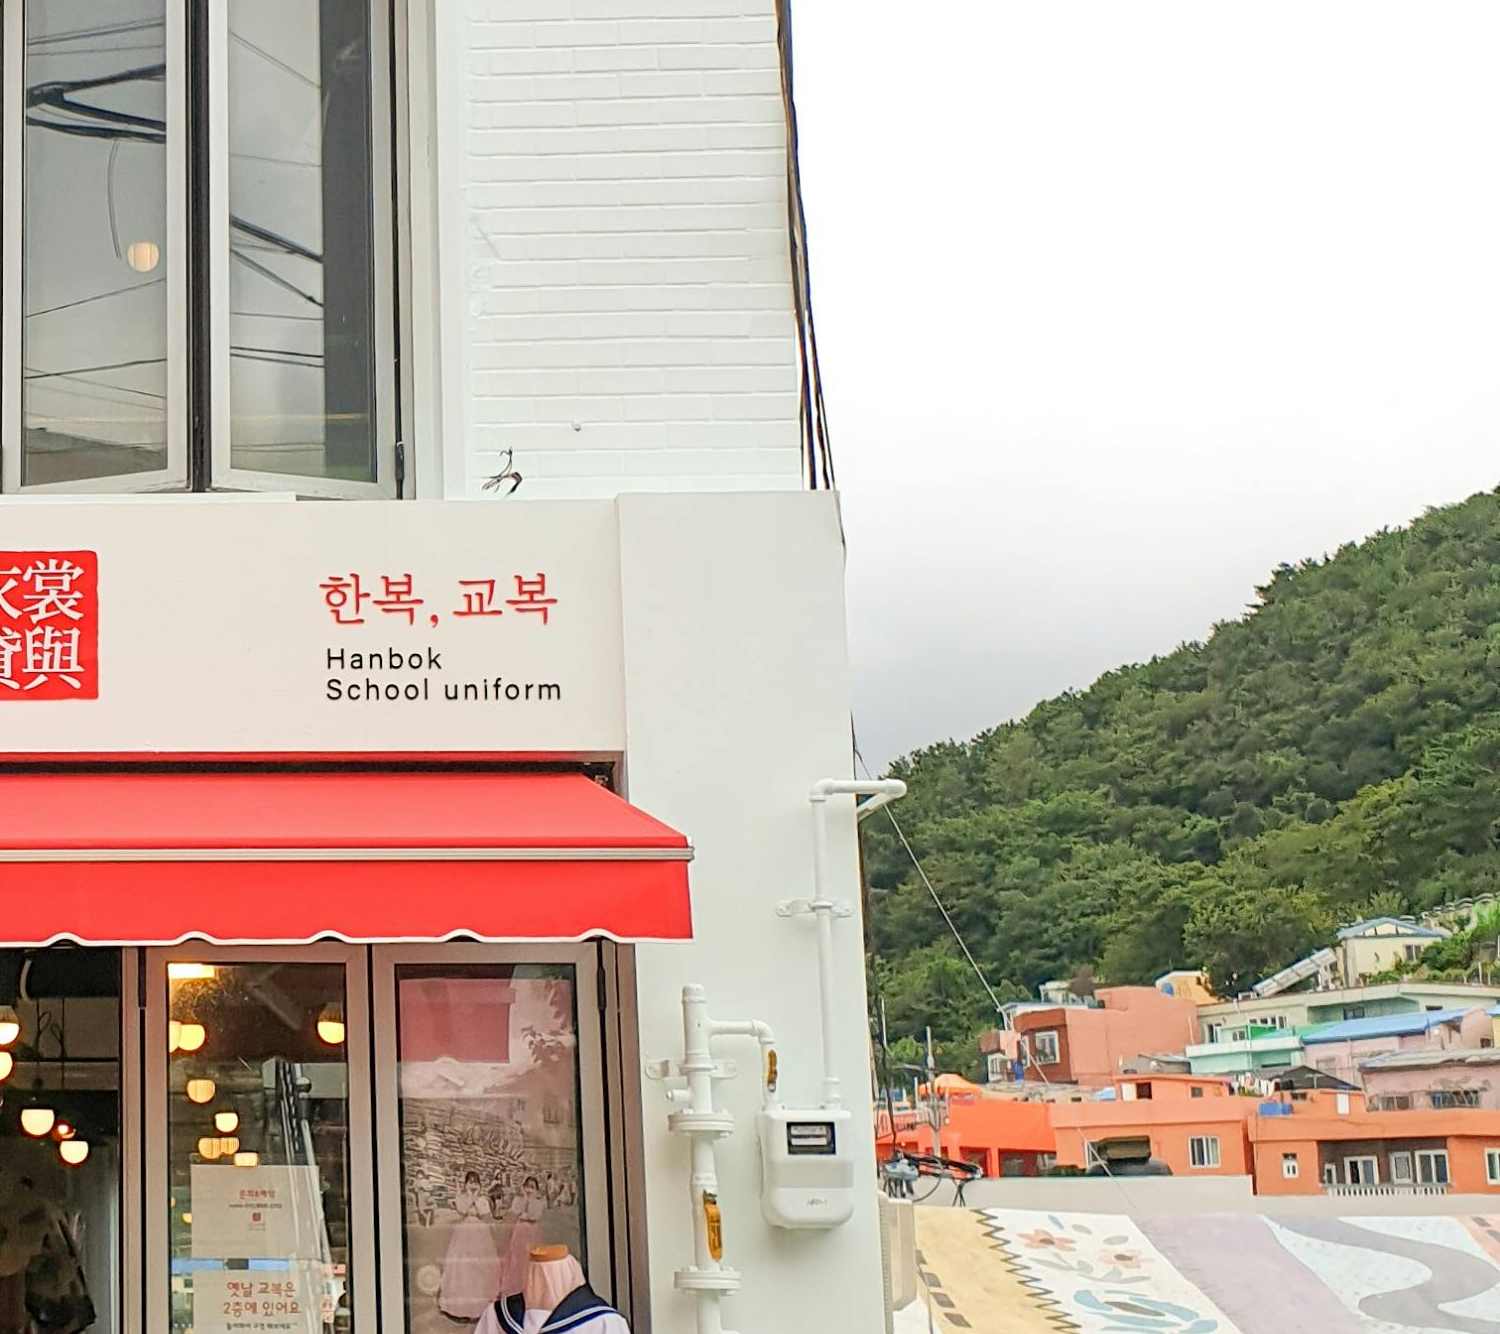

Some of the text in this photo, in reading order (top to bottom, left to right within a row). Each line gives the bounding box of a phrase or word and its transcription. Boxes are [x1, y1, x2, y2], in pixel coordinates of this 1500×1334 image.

[318, 572, 558, 628] 한복, 교복
[326, 647, 443, 670] Hanbok
[326, 677, 562, 701] School uniform
[227, 1281, 297, 1298] 옛날 교복은
[223, 1301, 257, 1318] 2층에
[262, 1301, 301, 1317] 있어요
